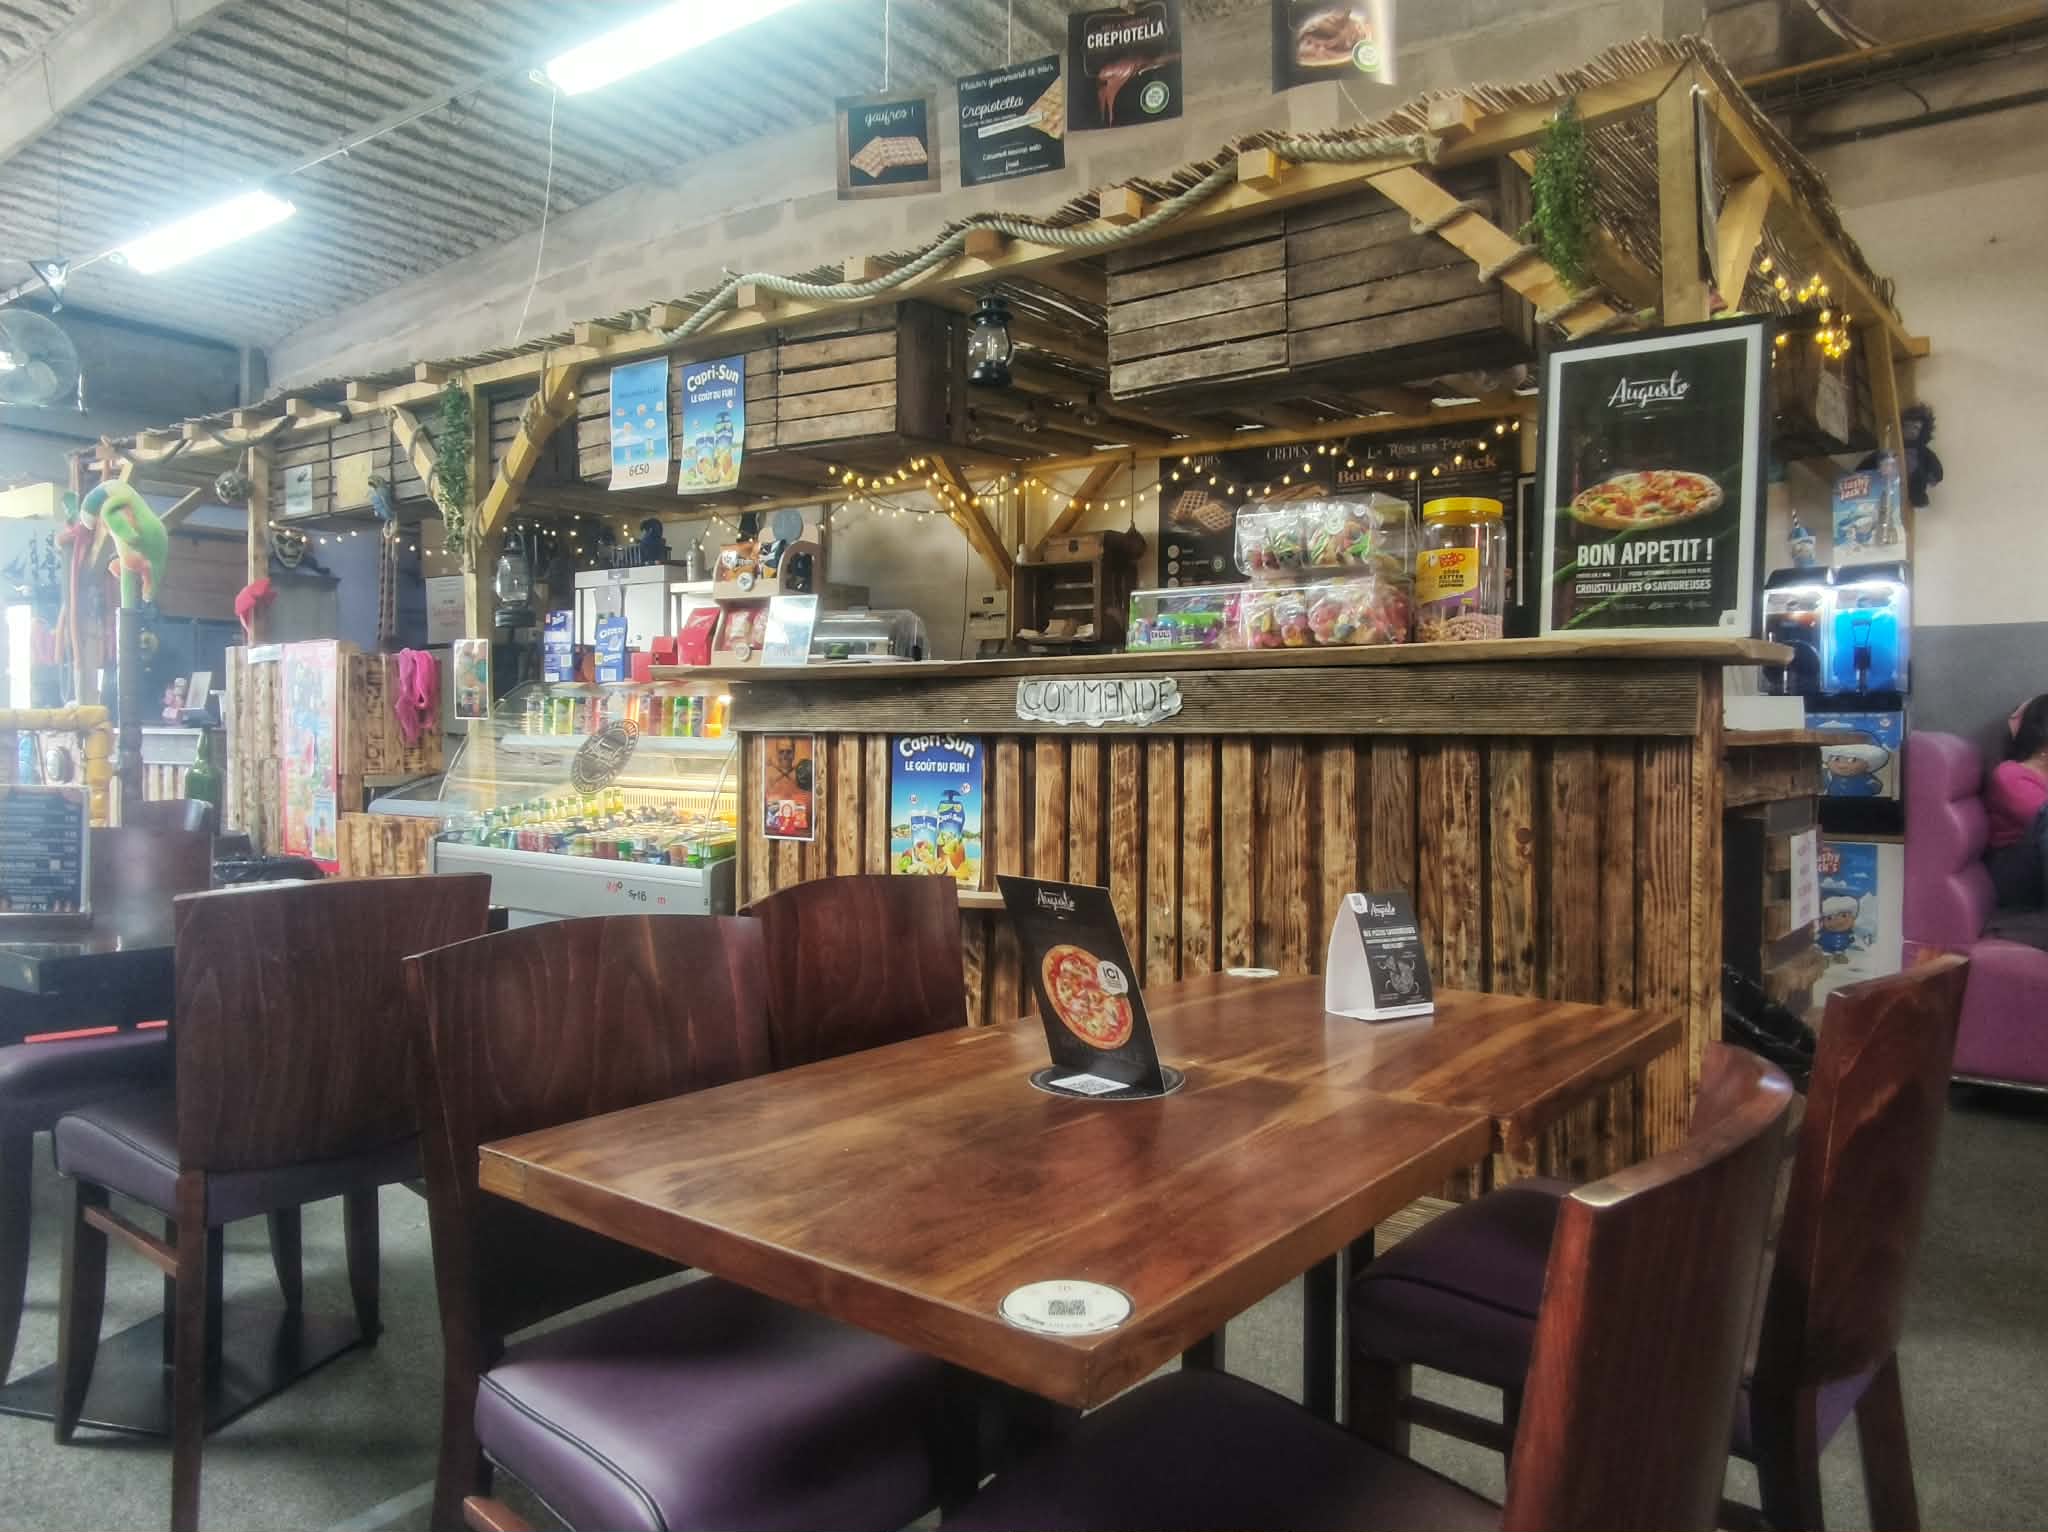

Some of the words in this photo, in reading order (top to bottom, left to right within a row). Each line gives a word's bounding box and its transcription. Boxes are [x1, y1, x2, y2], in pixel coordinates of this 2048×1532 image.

[1087, 20, 1164, 49] CREPIOTELLA
[961, 96, 1023, 119] Crepiotella
[687, 364, 739, 392] Capri-Sun
[1608, 370, 1689, 408] Augusto
[1577, 543, 1615, 567] BON
[1621, 538, 1702, 565] APPETIT
[1706, 537, 1713, 561] !
[1575, 582, 1643, 594] CROUSTILLANTES
[1651, 578, 1712, 593] SAVOUREUSES
[1023, 680, 1171, 715] COMMANDE
[899, 735, 976, 759] Capri-Sun
[905, 760, 914, 771] LE
[915, 758, 936, 772] GOÛT
[937, 761, 948, 772] DU
[949, 762, 965, 773] FUN
[1102, 966, 1121, 981] ICI
